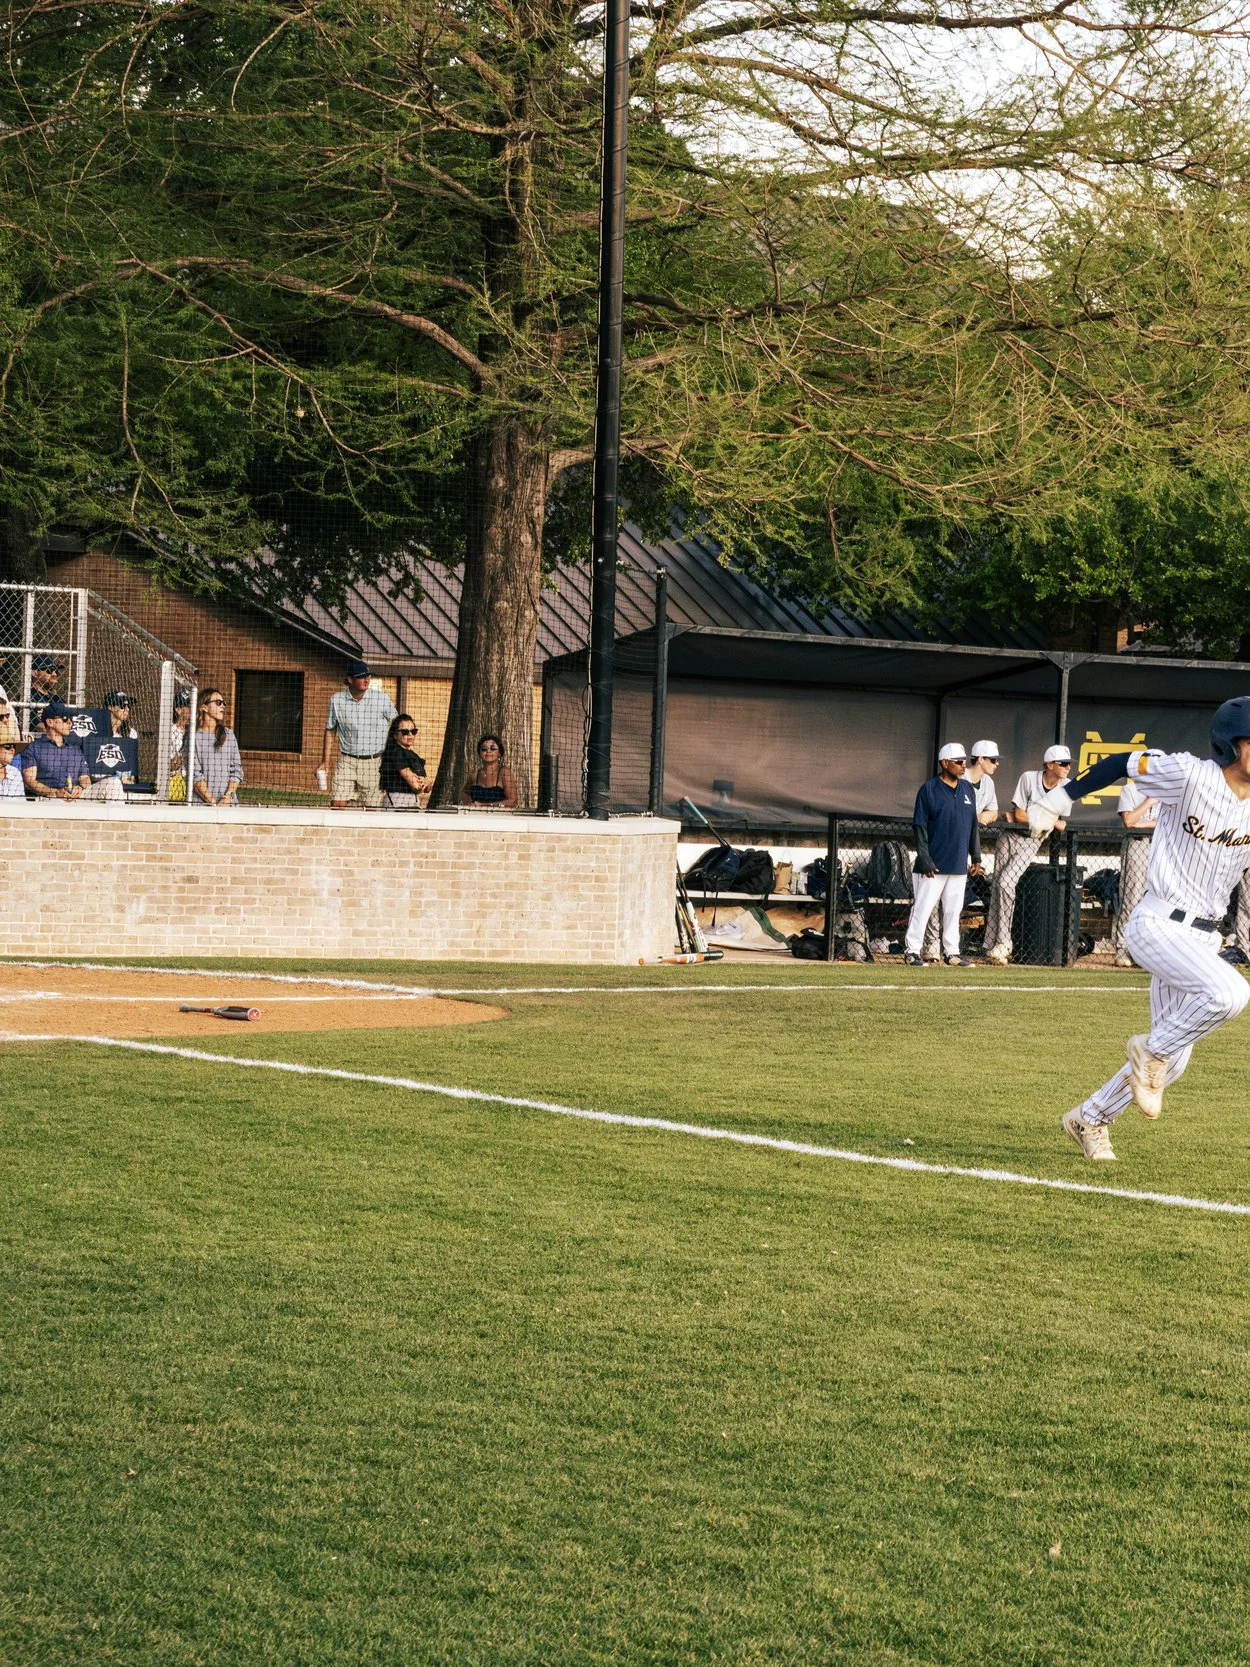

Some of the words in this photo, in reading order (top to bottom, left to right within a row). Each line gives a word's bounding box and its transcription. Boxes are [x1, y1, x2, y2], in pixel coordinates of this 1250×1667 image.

[72, 720, 97, 733] ESD
[99, 750, 124, 761] ESD
[1182, 815, 1206, 841] St.
